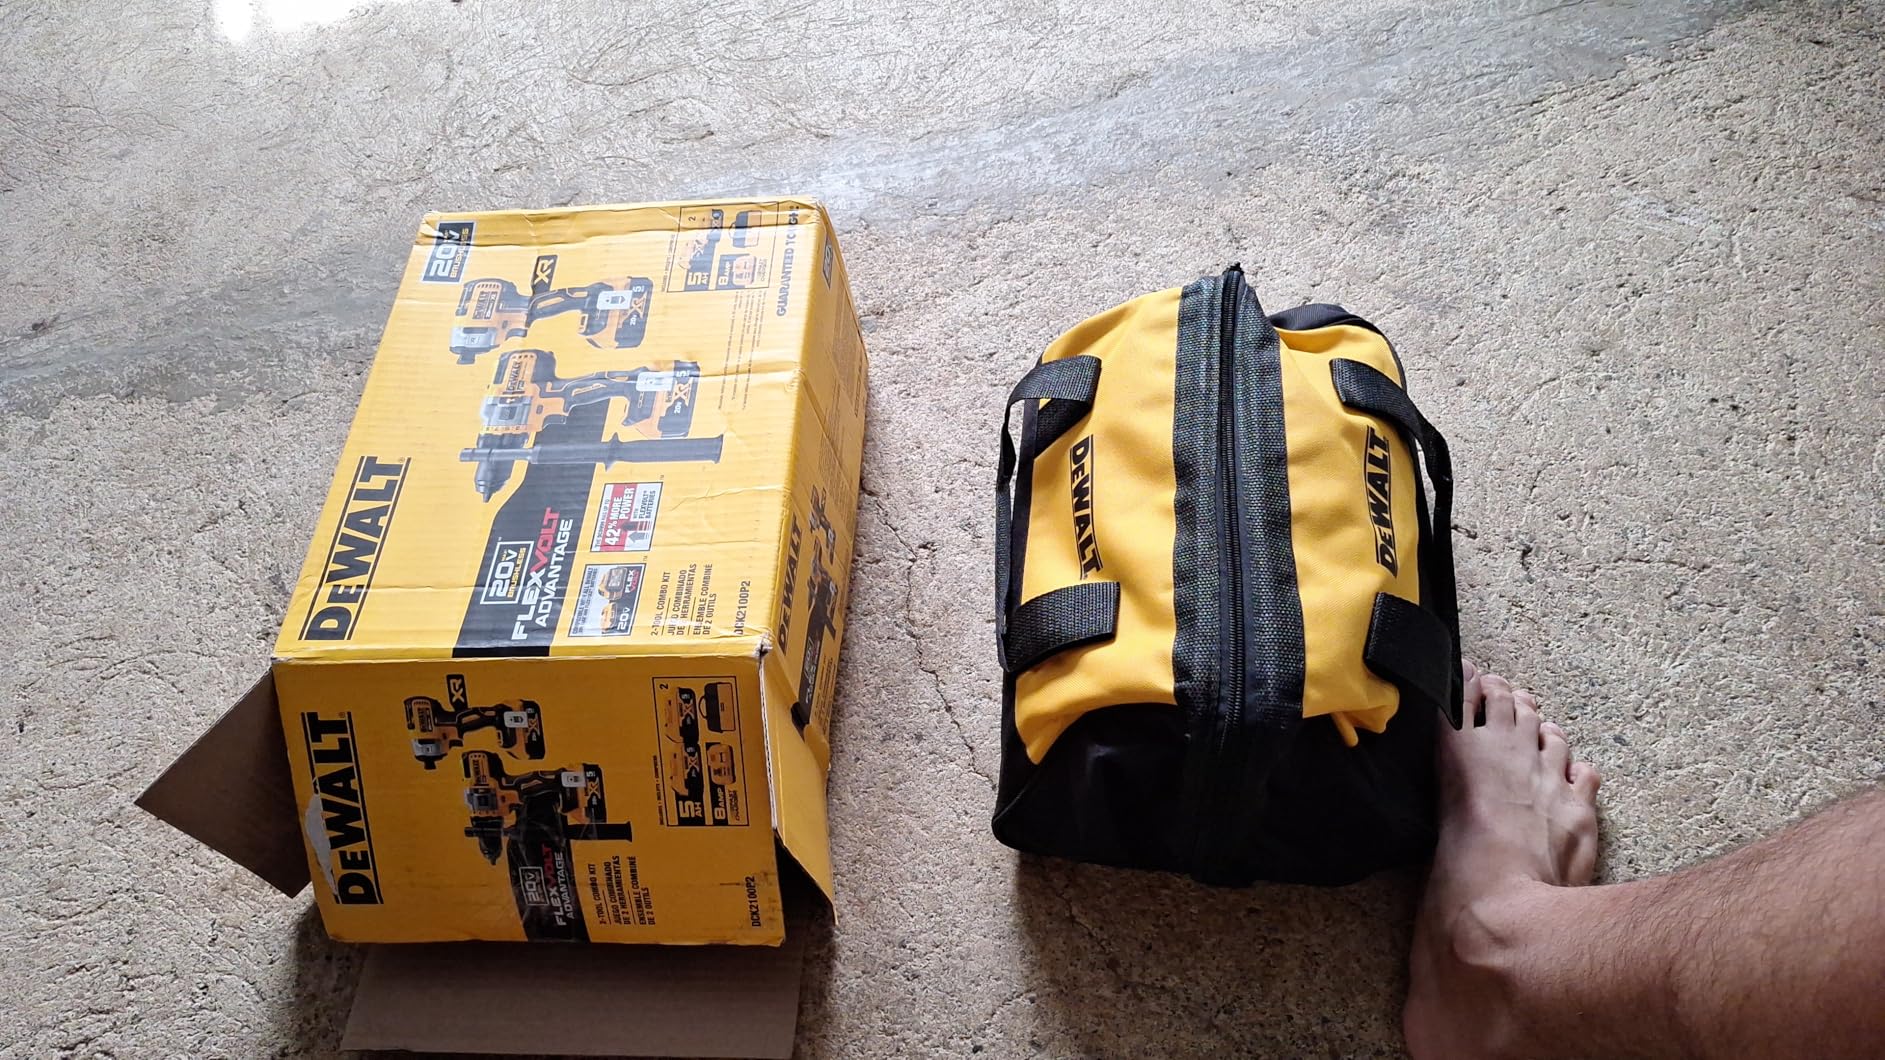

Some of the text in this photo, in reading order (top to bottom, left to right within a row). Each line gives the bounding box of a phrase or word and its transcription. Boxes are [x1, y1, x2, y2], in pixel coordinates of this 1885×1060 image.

[533, 259, 554, 284] XR
[687, 272, 702, 285] 5
[776, 248, 794, 317] GUARANTEED
[618, 487, 635, 520] POWER
[1071, 435, 1101, 576] DEWALT
[1366, 426, 1397, 577] DEWALT
[604, 496, 623, 545] 42% MORE
[304, 456, 405, 640] DEWALT
[489, 549, 518, 597] 20V
[511, 507, 560, 640] FLEXVOLT
[535, 519, 574, 628] ADVANTAGE
[624, 570, 635, 593] FLEX
[656, 584, 668, 610] COMBO
[662, 571, 671, 582] KIT
[672, 570, 688, 612] COMBINADO
[680, 563, 697, 618] HERRAMIENTAS
[777, 512, 802, 656] DEWALT
[617, 606, 631, 630] 20V
[706, 593, 717, 618] OUTILS
[677, 626, 686, 635] DE
[702, 626, 712, 635] DE
[449, 678, 465, 704] XR
[306, 712, 378, 904] DEWALT
[678, 800, 695, 818] 5
[694, 801, 703, 818] AH
[716, 786, 726, 808] AMP
[524, 871, 540, 902] 20V
[541, 842, 568, 926] FLEXVOLT
[554, 851, 576, 920] ADVANTAGE
[588, 864, 596, 874] KIT
[604, 861, 618, 903] COMBINADO
[612, 855, 628, 908] HERRAMIENTAS
[632, 892, 647, 924] ENSEMBLE
[640, 888, 652, 909] OUTILS
[744, 876, 761, 926] DCK2100P2
[623, 916, 632, 924] DE
[647, 916, 656, 925] DE
